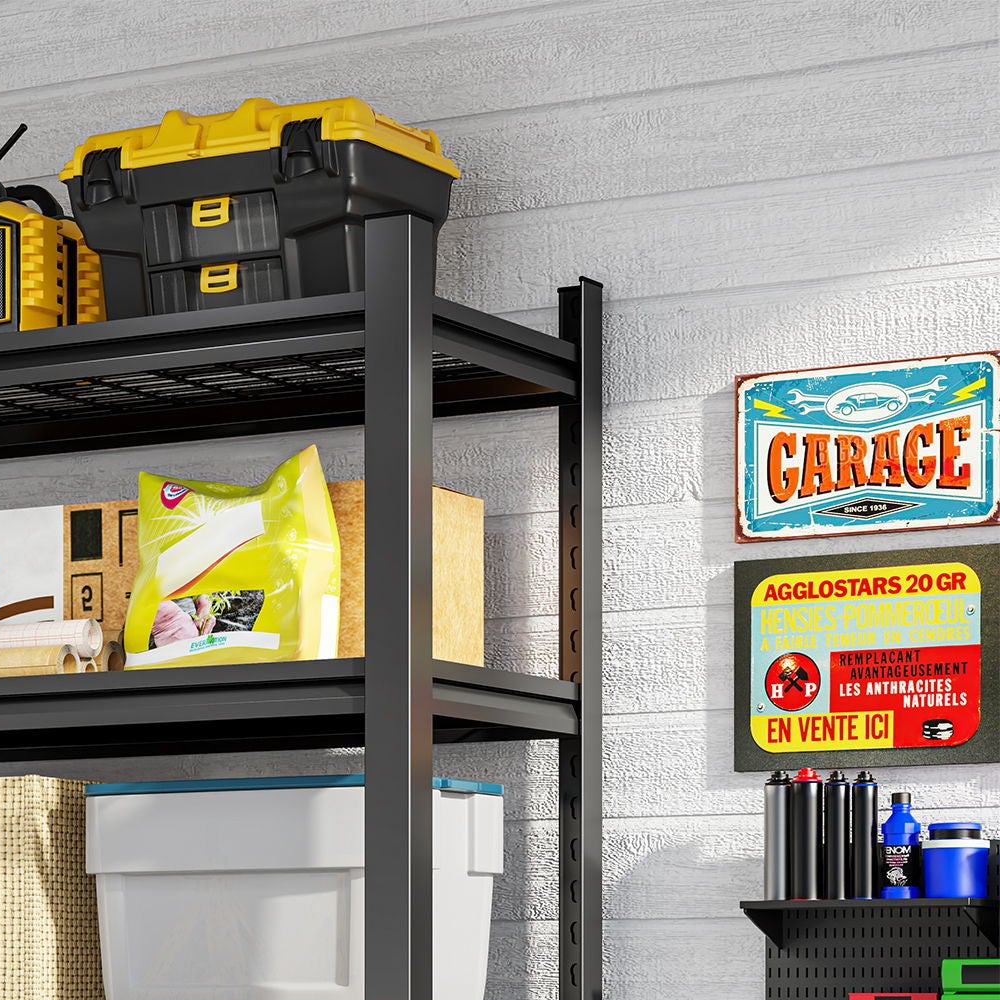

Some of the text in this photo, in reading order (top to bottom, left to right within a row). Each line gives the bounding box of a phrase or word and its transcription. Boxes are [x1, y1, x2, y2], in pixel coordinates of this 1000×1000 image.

[767, 415, 971, 504] GARAGE
[844, 505, 868, 513] SINCE
[764, 572, 967, 601] AGGLOSTARS 20 GR
[776, 635, 816, 650] FAIBLE
[826, 631, 875, 647] TENEUR
[884, 629, 900, 644] EN
[909, 626, 971, 643] CENDRES
[850, 662, 968, 680] AVANTAGEUSEMENT
[771, 683, 817, 698] H P
[839, 678, 952, 696] LES ANTHRACITES
[903, 692, 968, 708] NATURELS
[767, 713, 889, 743] EN VENTE ICI
